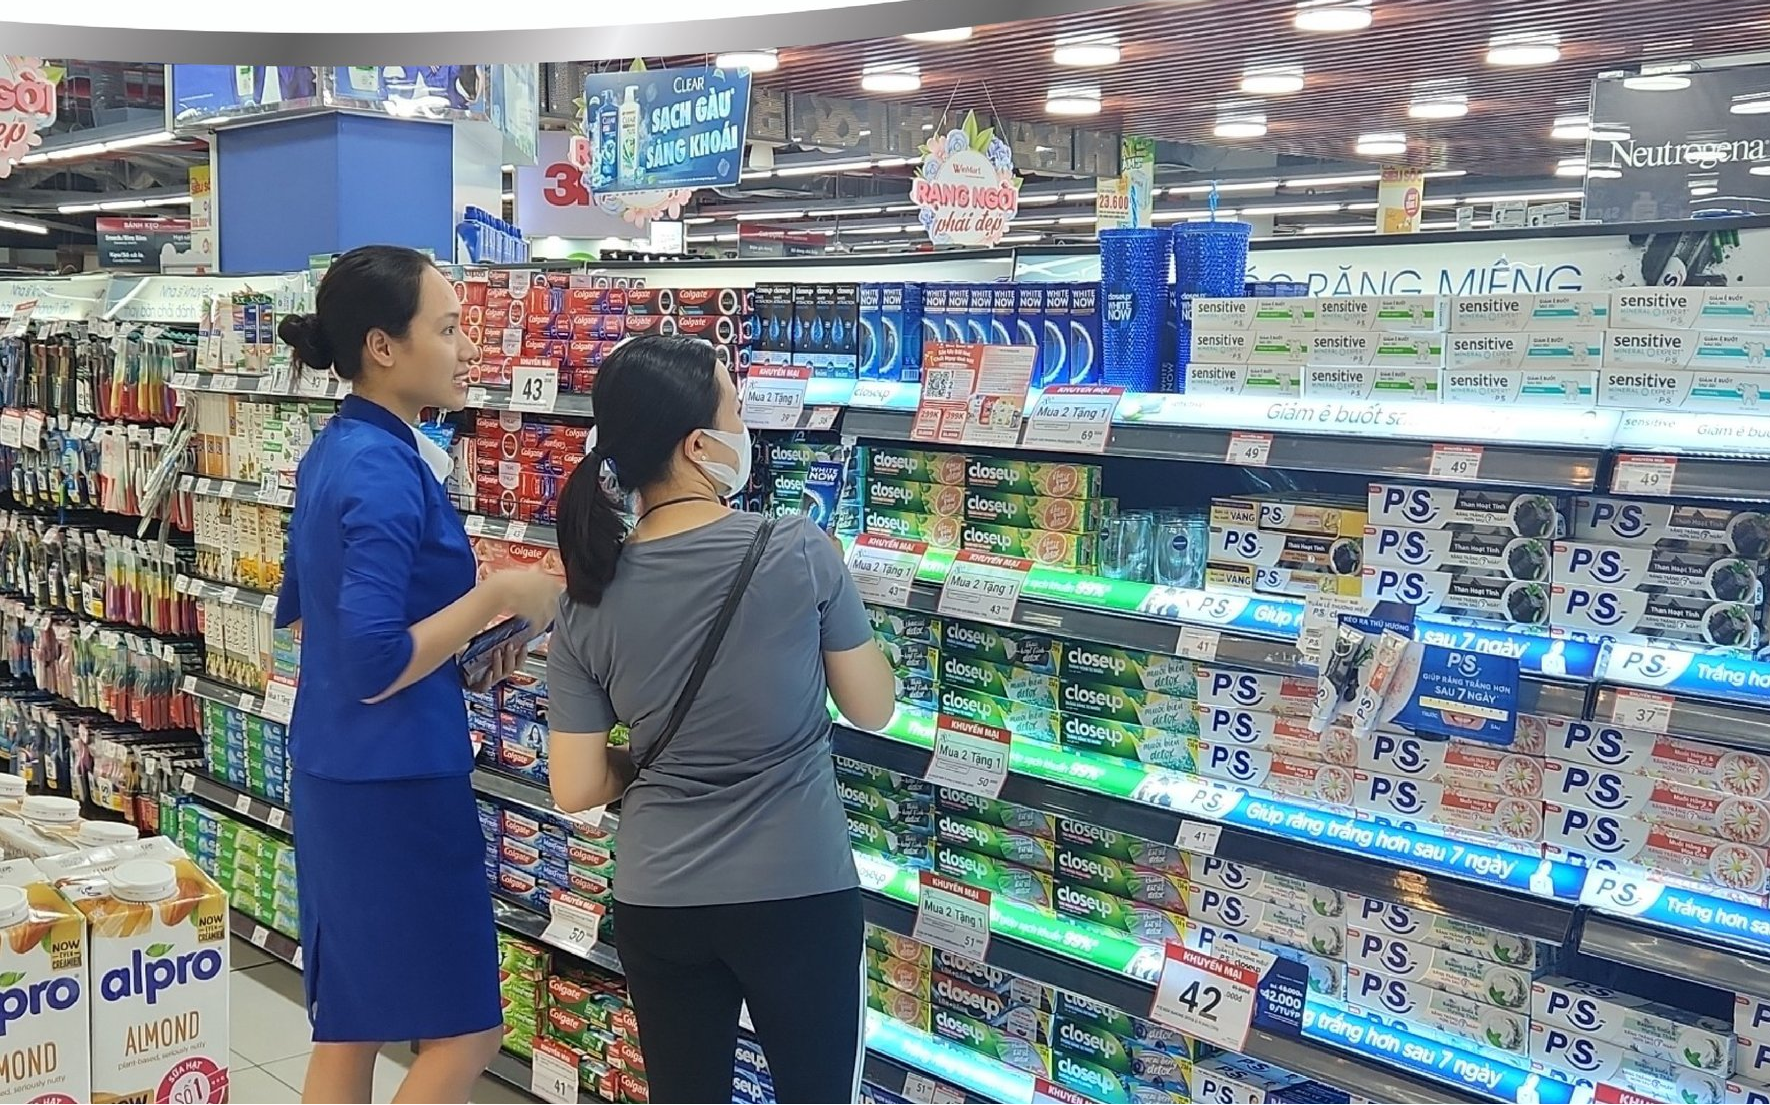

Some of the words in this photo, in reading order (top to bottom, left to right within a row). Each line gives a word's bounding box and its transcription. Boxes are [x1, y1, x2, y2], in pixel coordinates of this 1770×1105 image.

[673, 75, 705, 94] CLEAR
[651, 100, 691, 134] SẠCH
[646, 138, 686, 169] SẢNG
[689, 120, 738, 158] KHOÁI
[1611, 139, 1765, 169] Neutrogena
[917, 182, 970, 211] RẠNG
[1099, 194, 1129, 210] 23.600
[935, 210, 973, 235] phái
[975, 210, 1003, 236] đẹp
[573, 289, 600, 299] Colgate
[679, 289, 708, 299] Colgate
[1071, 289, 1096, 297] WHITE
[1620, 293, 1687, 308] sensitive
[1072, 297, 1095, 308] NOW
[1198, 299, 1246, 313] sensitive
[1459, 297, 1520, 313] sensitive
[679, 317, 707, 327] Colgate
[1107, 310, 1131, 321] NOW
[1314, 334, 1366, 349] sensitive
[1614, 334, 1681, 348] sensitive
[1608, 373, 1676, 388] sensitive
[522, 377, 543, 403] 43
[748, 391, 766, 402] Mua
[767, 392, 772, 402] 2
[774, 392, 793, 405] Tặng
[1037, 405, 1059, 417] Mua
[1060, 406, 1067, 417] 2
[1073, 406, 1098, 421] Tặng
[1267, 402, 1313, 420] Giảm
[1335, 403, 1380, 425] buốt
[1081, 430, 1093, 440] 69
[772, 446, 810, 466] closeup
[1245, 447, 1259, 458] 49
[811, 466, 839, 475] WHITE
[873, 451, 918, 475] closeup
[808, 472, 838, 482] NOW
[968, 461, 1020, 486] closeup
[1640, 472, 1659, 486] 49
[868, 537, 898, 551] KHUYẾN
[852, 559, 872, 572] Mua
[873, 562, 879, 573] 2
[883, 563, 903, 578] Tặng
[888, 585, 899, 596] 43
[950, 576, 971, 588] Mua
[972, 579, 979, 589] 2
[983, 580, 1006, 595] Tặng
[990, 605, 1001, 615] 43
[1358, 617, 1370, 627] RA
[1197, 641, 1209, 652] 41
[1424, 631, 1457, 649] sau
[1462, 631, 1475, 647] 7
[1068, 647, 1126, 676] closeup
[1697, 661, 1746, 687] Trắng
[1422, 672, 1439, 682] GIÚP
[1442, 675, 1464, 686] RĂNG
[1465, 678, 1491, 690] TRẮNG
[1493, 684, 1511, 695] HƠN
[1435, 686, 1455, 697] SAU
[1458, 688, 1465, 700] 7
[1467, 688, 1495, 704] NGÀY
[1635, 709, 1655, 722] 37
[951, 719, 984, 735] KHUYẾN
[984, 728, 1000, 740] MẠI
[1065, 718, 1123, 747] closeup
[939, 744, 959, 758] Mua
[961, 749, 968, 761] 2
[971, 751, 993, 769] Tặng
[977, 776, 989, 787] 50
[1246, 801, 1285, 826] Giúp
[1285, 811, 1326, 836] răng
[1326, 819, 1374, 848] trắng
[1374, 830, 1411, 855] hơn
[1412, 841, 1446, 861] sau
[1450, 845, 1463, 864] 7
[1464, 853, 1515, 879] ngày
[570, 848, 600, 864] Colgate
[571, 875, 599, 892] Colgate
[931, 877, 963, 894] KHUYẾN
[964, 889, 980, 900] MẠI
[199, 914, 224, 927] NOW
[924, 899, 944, 915] Mua
[946, 908, 952, 917] 2
[955, 909, 976, 928] Tặng
[52, 939, 80, 952] NOW
[964, 935, 975, 947] 51
[1182, 951, 1223, 975] KHUYẾN
[1223, 966, 1243, 981] MẠI
[100, 947, 223, 1005] alpro
[549, 978, 581, 1001] Colgate
[1178, 980, 1222, 1022] 42
[125, 1010, 200, 1058] ALMOND
